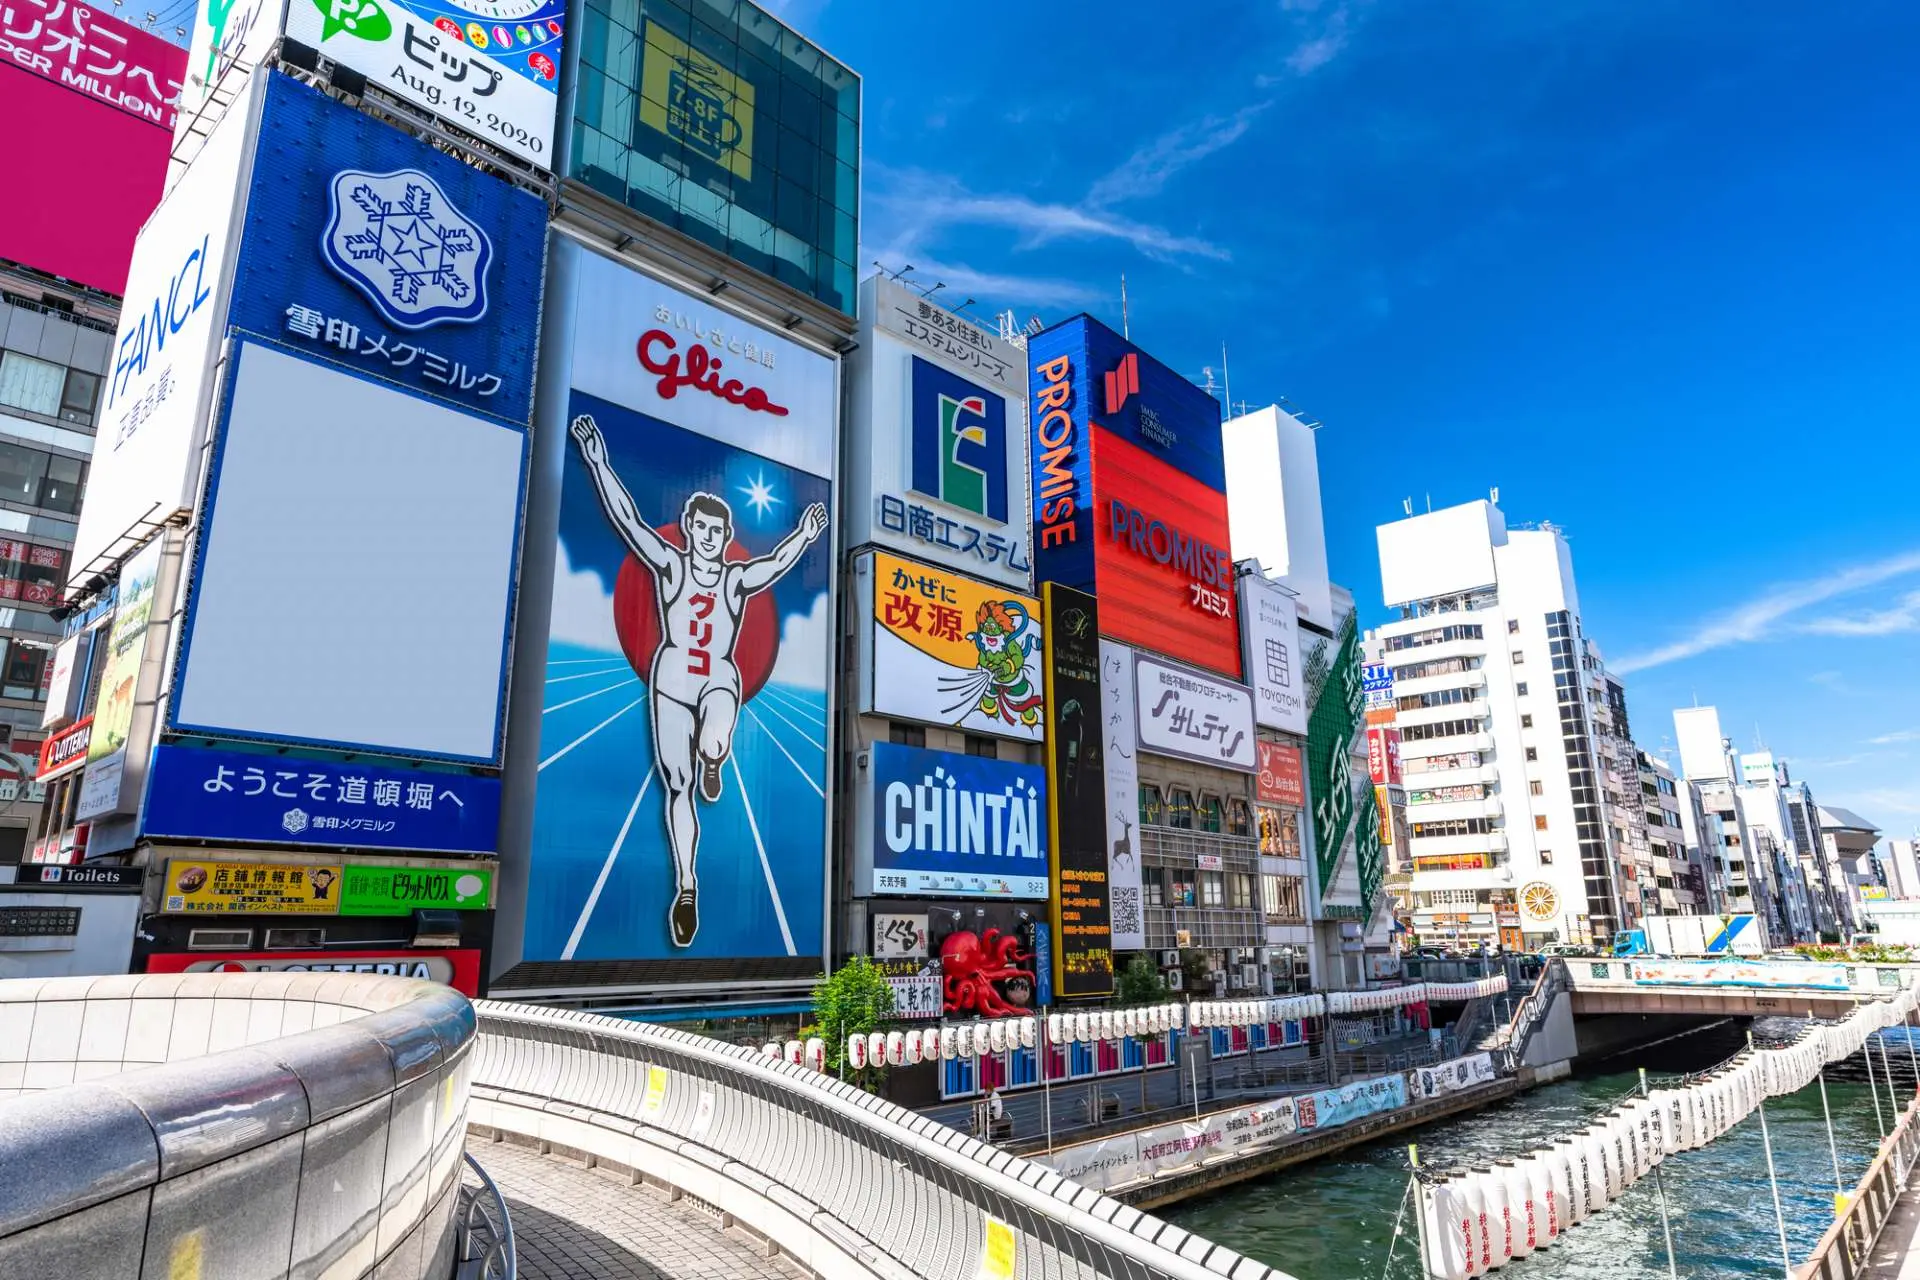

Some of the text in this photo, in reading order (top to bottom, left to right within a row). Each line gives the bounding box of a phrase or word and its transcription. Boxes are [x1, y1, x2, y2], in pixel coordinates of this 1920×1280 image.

[403, 22, 502, 96] ピップ
[61, 66, 163, 122] MILLION
[391, 65, 543, 153] Aug. 12, 2020
[109, 233, 211, 410] FANCL
[655, 304, 776, 370] おいしさと健康
[918, 300, 993, 350] 夢ある住まい
[286, 303, 502, 396] 雪印メグミルク
[637, 329, 789, 417] Glico
[905, 319, 1006, 381] エステムシリーズ
[1037, 354, 1076, 549] PROMISE
[1140, 414, 1178, 442] CONSUMER
[1141, 424, 1171, 449] FINANCE
[882, 494, 1031, 572] 日商エステム
[1111, 498, 1230, 591] PROMISE
[892, 568, 958, 604] かぜに
[1190, 582, 1232, 619] プロミス
[688, 592, 718, 676] グリコ
[884, 592, 965, 643] 改源
[1259, 687, 1301, 709] TOYOTOMI
[1370, 738, 1382, 775] カラオケ
[203, 765, 465, 811] ようこそ道頓堀へ
[885, 766, 1039, 859] CHINTAI
[312, 816, 396, 832] 雪印メグミルク
[67, 869, 120, 882] Toilets
[392, 872, 449, 901] ピタットハウス
[885, 919, 918, 951] くくる
